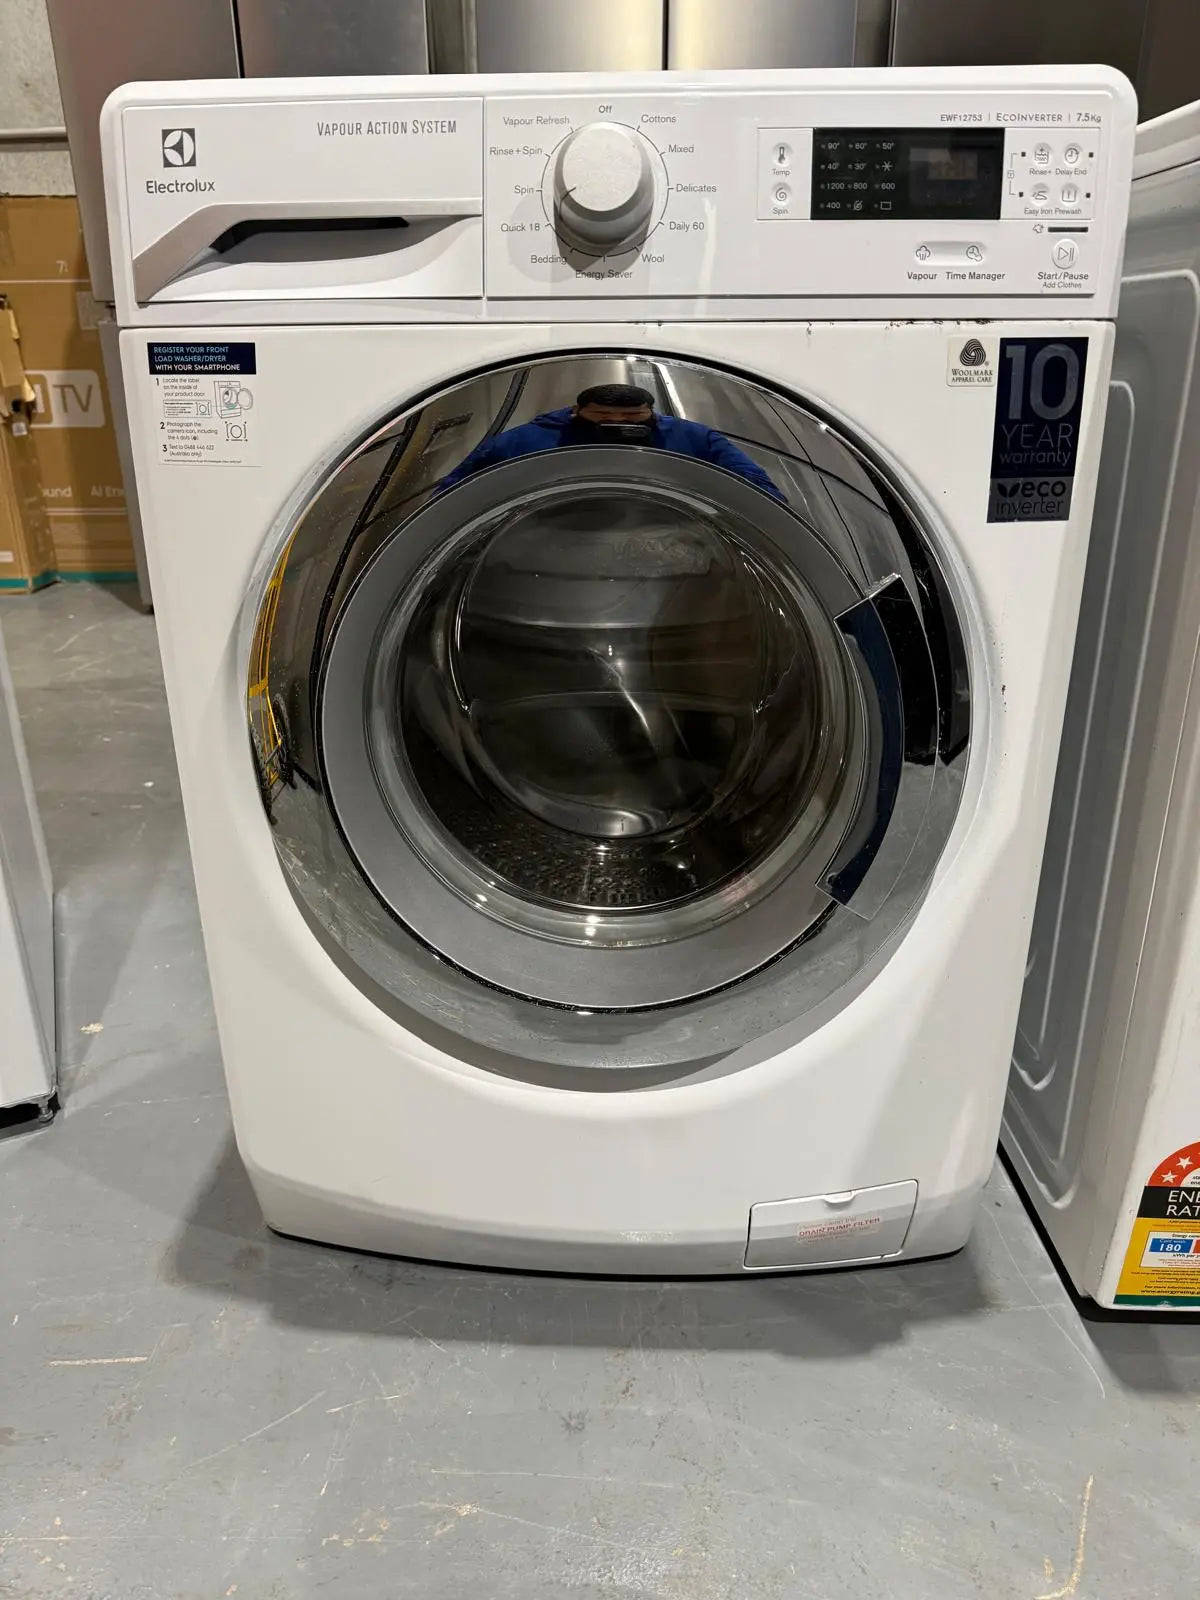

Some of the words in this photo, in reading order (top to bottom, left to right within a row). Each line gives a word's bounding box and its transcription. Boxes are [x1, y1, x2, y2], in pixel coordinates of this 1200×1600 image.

[504, 117, 533, 126] Vapour
[536, 116, 570, 125] Refresh
[641, 115, 676, 123] Cottons
[317, 122, 362, 136] VAPOUR
[367, 121, 408, 135] ACTION
[412, 120, 457, 134] SYSTEM
[668, 145, 694, 153] Mixed
[146, 179, 215, 194] Electrolux
[514, 186, 534, 194] Spin
[676, 184, 717, 192] Delicates
[501, 224, 526, 232] Quick
[669, 222, 690, 231] Daily
[530, 255, 567, 264] Bedding
[642, 254, 664, 262] Wool
[576, 271, 605, 279] Energy
[607, 270, 632, 278] Saver
[907, 272, 937, 281] Vapour
[968, 272, 1005, 281] Manager
[1038, 272, 1089, 280] Start/Pause
[1006, 344, 1079, 420] 10
[53, 385, 92, 413] TV
[1002, 423, 1073, 449] YEAR
[1000, 451, 1071, 466] warranty
[1021, 481, 1066, 497] eco
[996, 496, 1063, 514] inverter
[853, 1218, 880, 1227] FILTER
